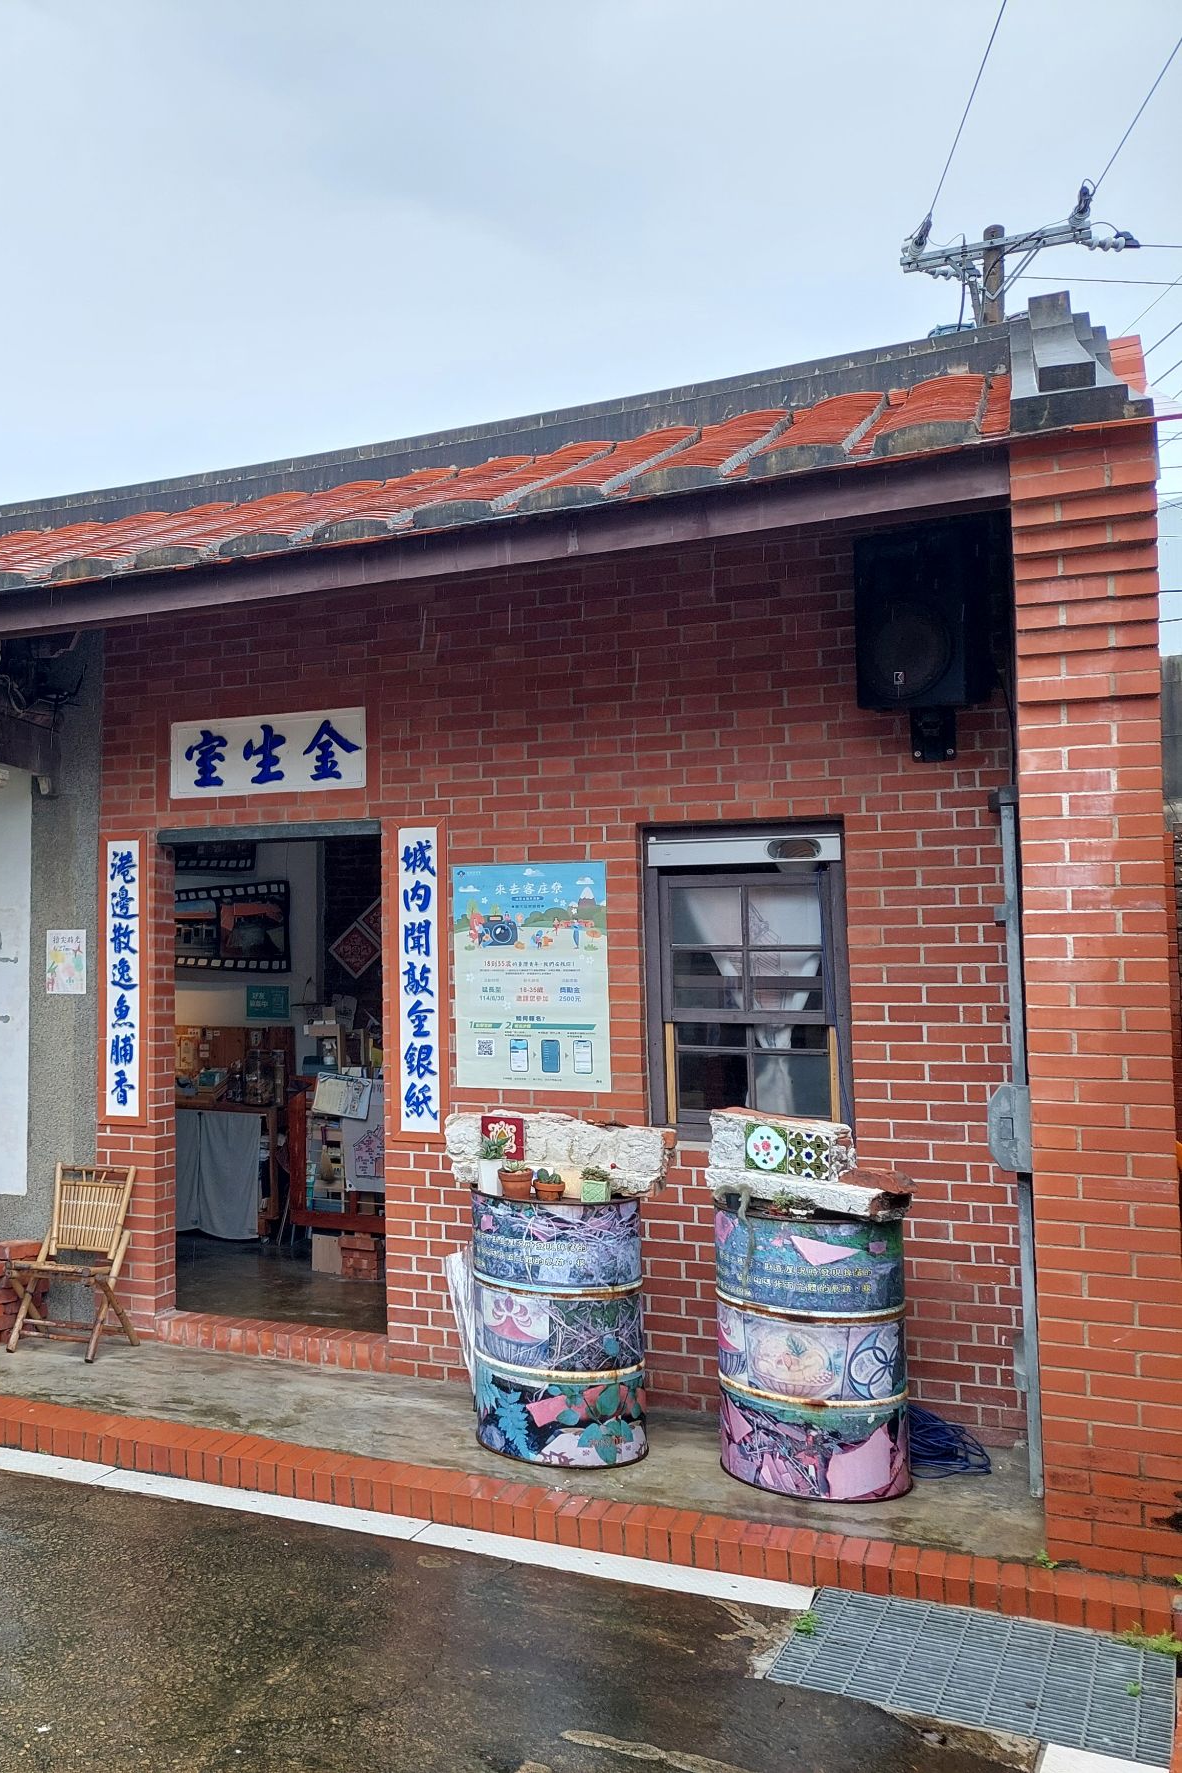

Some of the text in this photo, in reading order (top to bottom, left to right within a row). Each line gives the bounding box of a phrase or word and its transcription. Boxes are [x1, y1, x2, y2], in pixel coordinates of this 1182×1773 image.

[184, 719, 362, 788] 金生室
[110, 850, 139, 1107] 港邊散逸魚脯香
